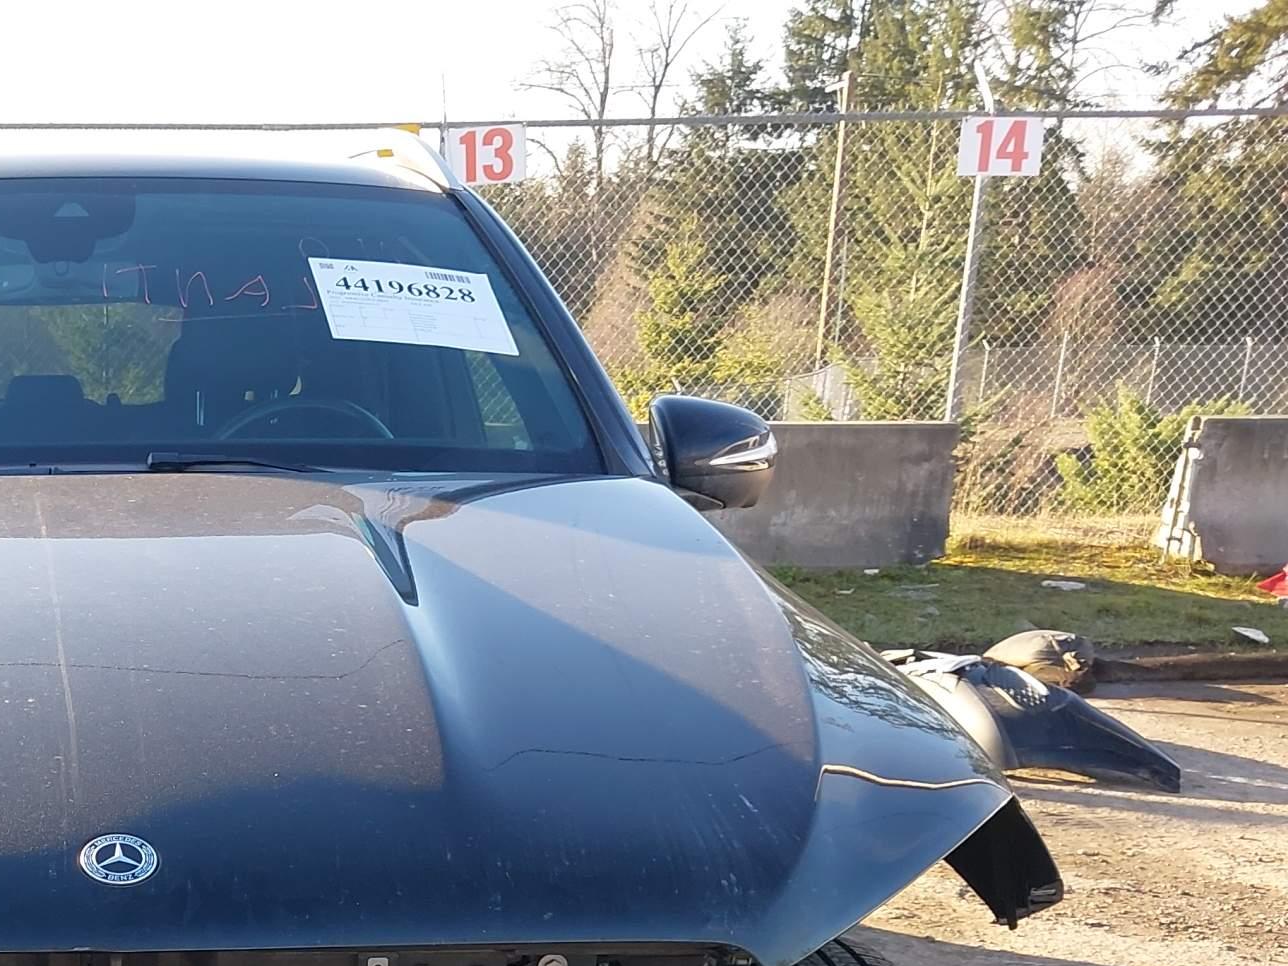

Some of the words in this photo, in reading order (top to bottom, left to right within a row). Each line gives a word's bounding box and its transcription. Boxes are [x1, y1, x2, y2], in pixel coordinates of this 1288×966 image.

[459, 127, 514, 183] 13
[976, 119, 1029, 172] 14
[335, 275, 476, 303] 44196828
[107, 873, 135, 882] BENZ
